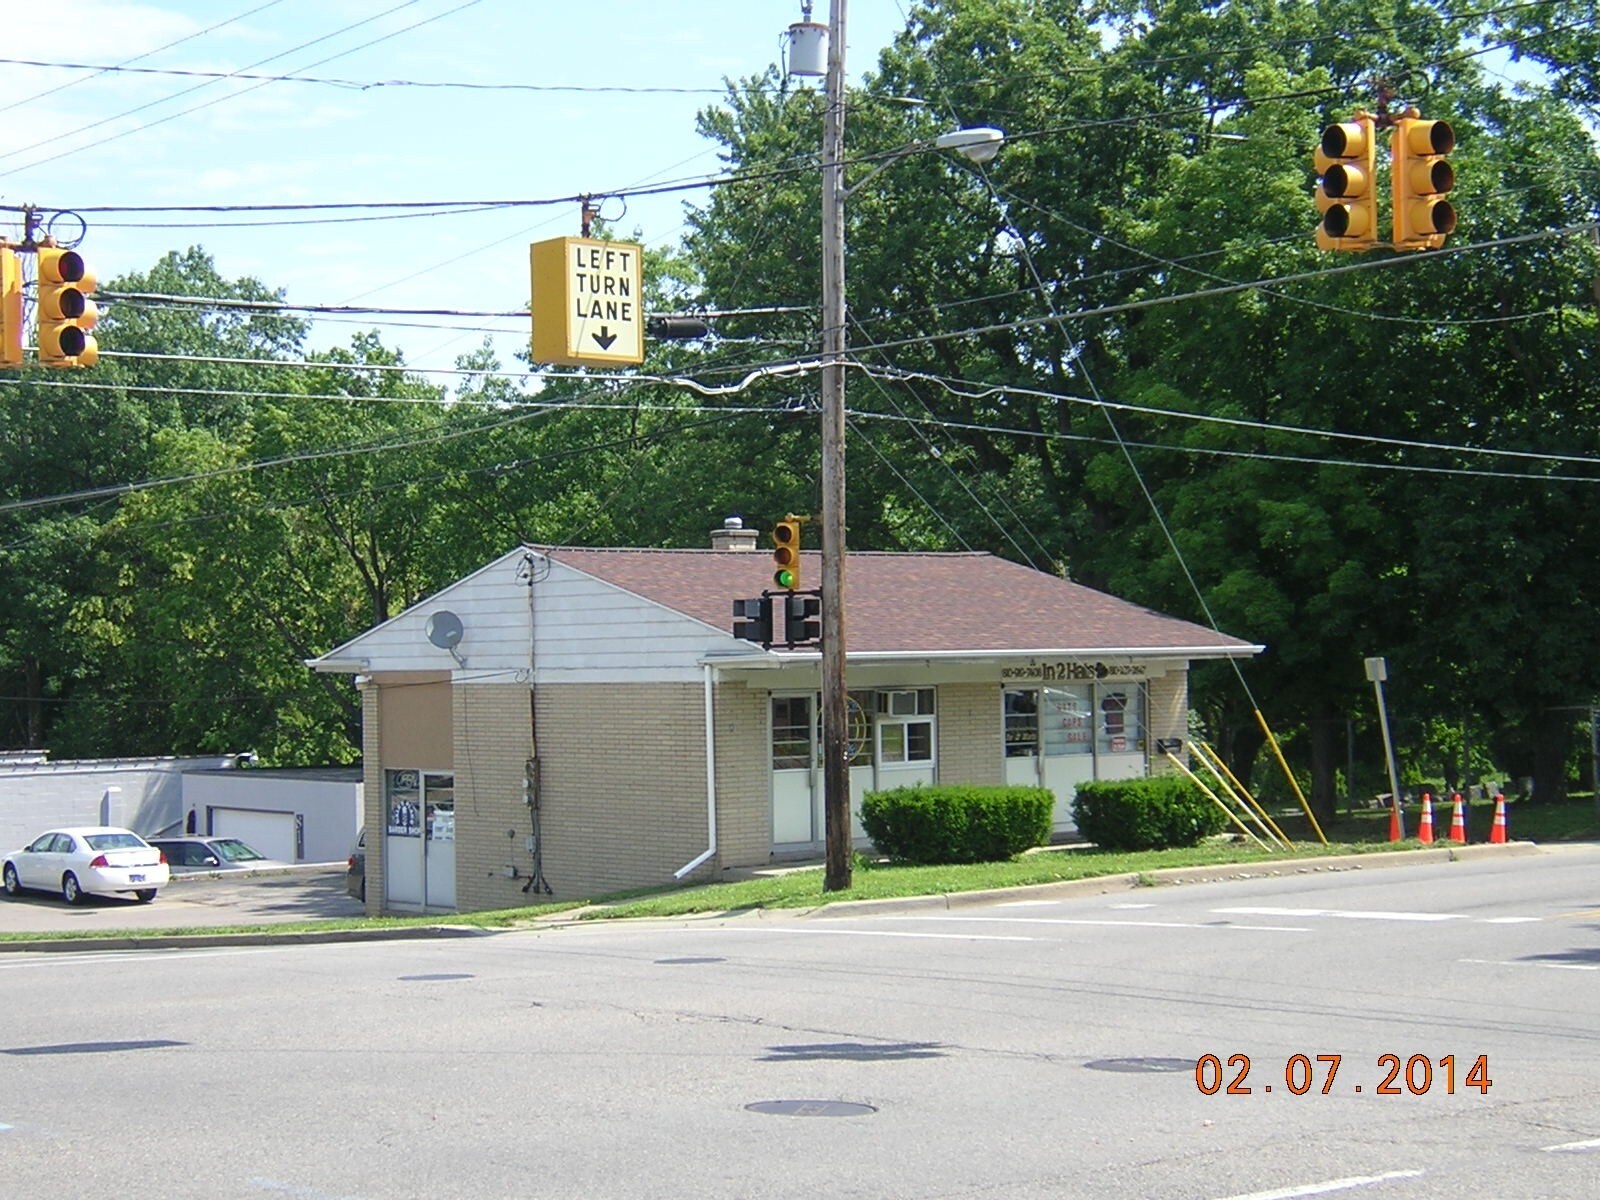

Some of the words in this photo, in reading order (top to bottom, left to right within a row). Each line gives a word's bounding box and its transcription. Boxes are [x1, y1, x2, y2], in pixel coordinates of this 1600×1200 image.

[577, 247, 630, 272] LEFT
[576, 273, 630, 297] TURN
[576, 298, 632, 322] LANE
